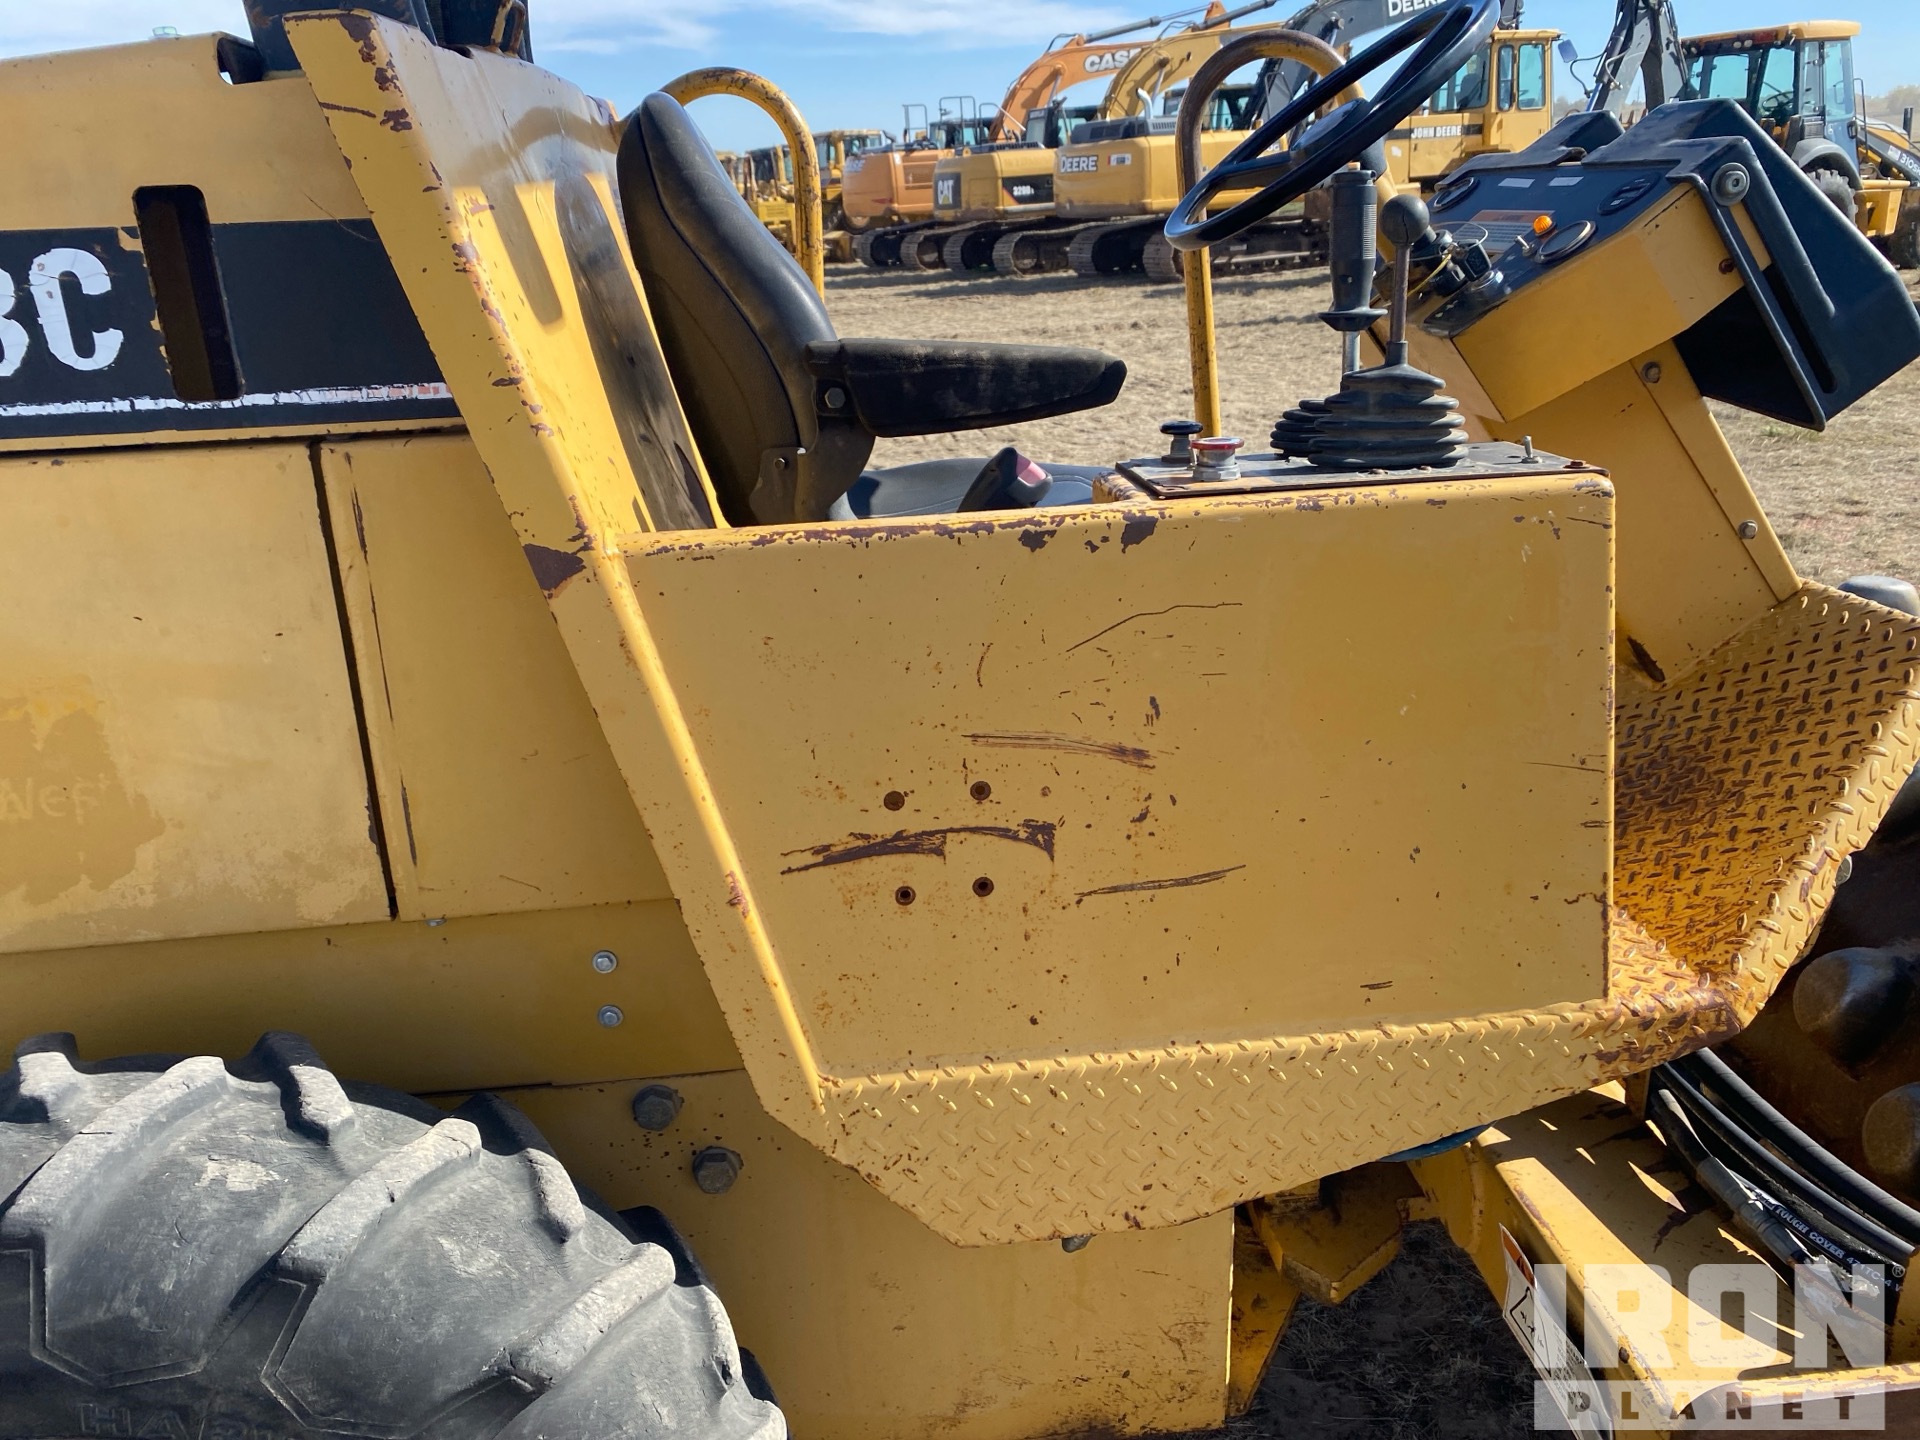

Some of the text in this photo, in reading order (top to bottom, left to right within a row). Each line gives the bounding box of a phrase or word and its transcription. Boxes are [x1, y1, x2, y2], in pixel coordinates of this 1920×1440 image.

[1388, 0, 1447, 17] DEE
[1410, 127, 1435, 139] JOHN
[1436, 125, 1462, 137] DEERE
[1060, 156, 1098, 173] DEERE
[937, 179, 954, 205] CAT
[1776, 1206, 1810, 1234] TOUGH
[1809, 1232, 1845, 1259] COVER
